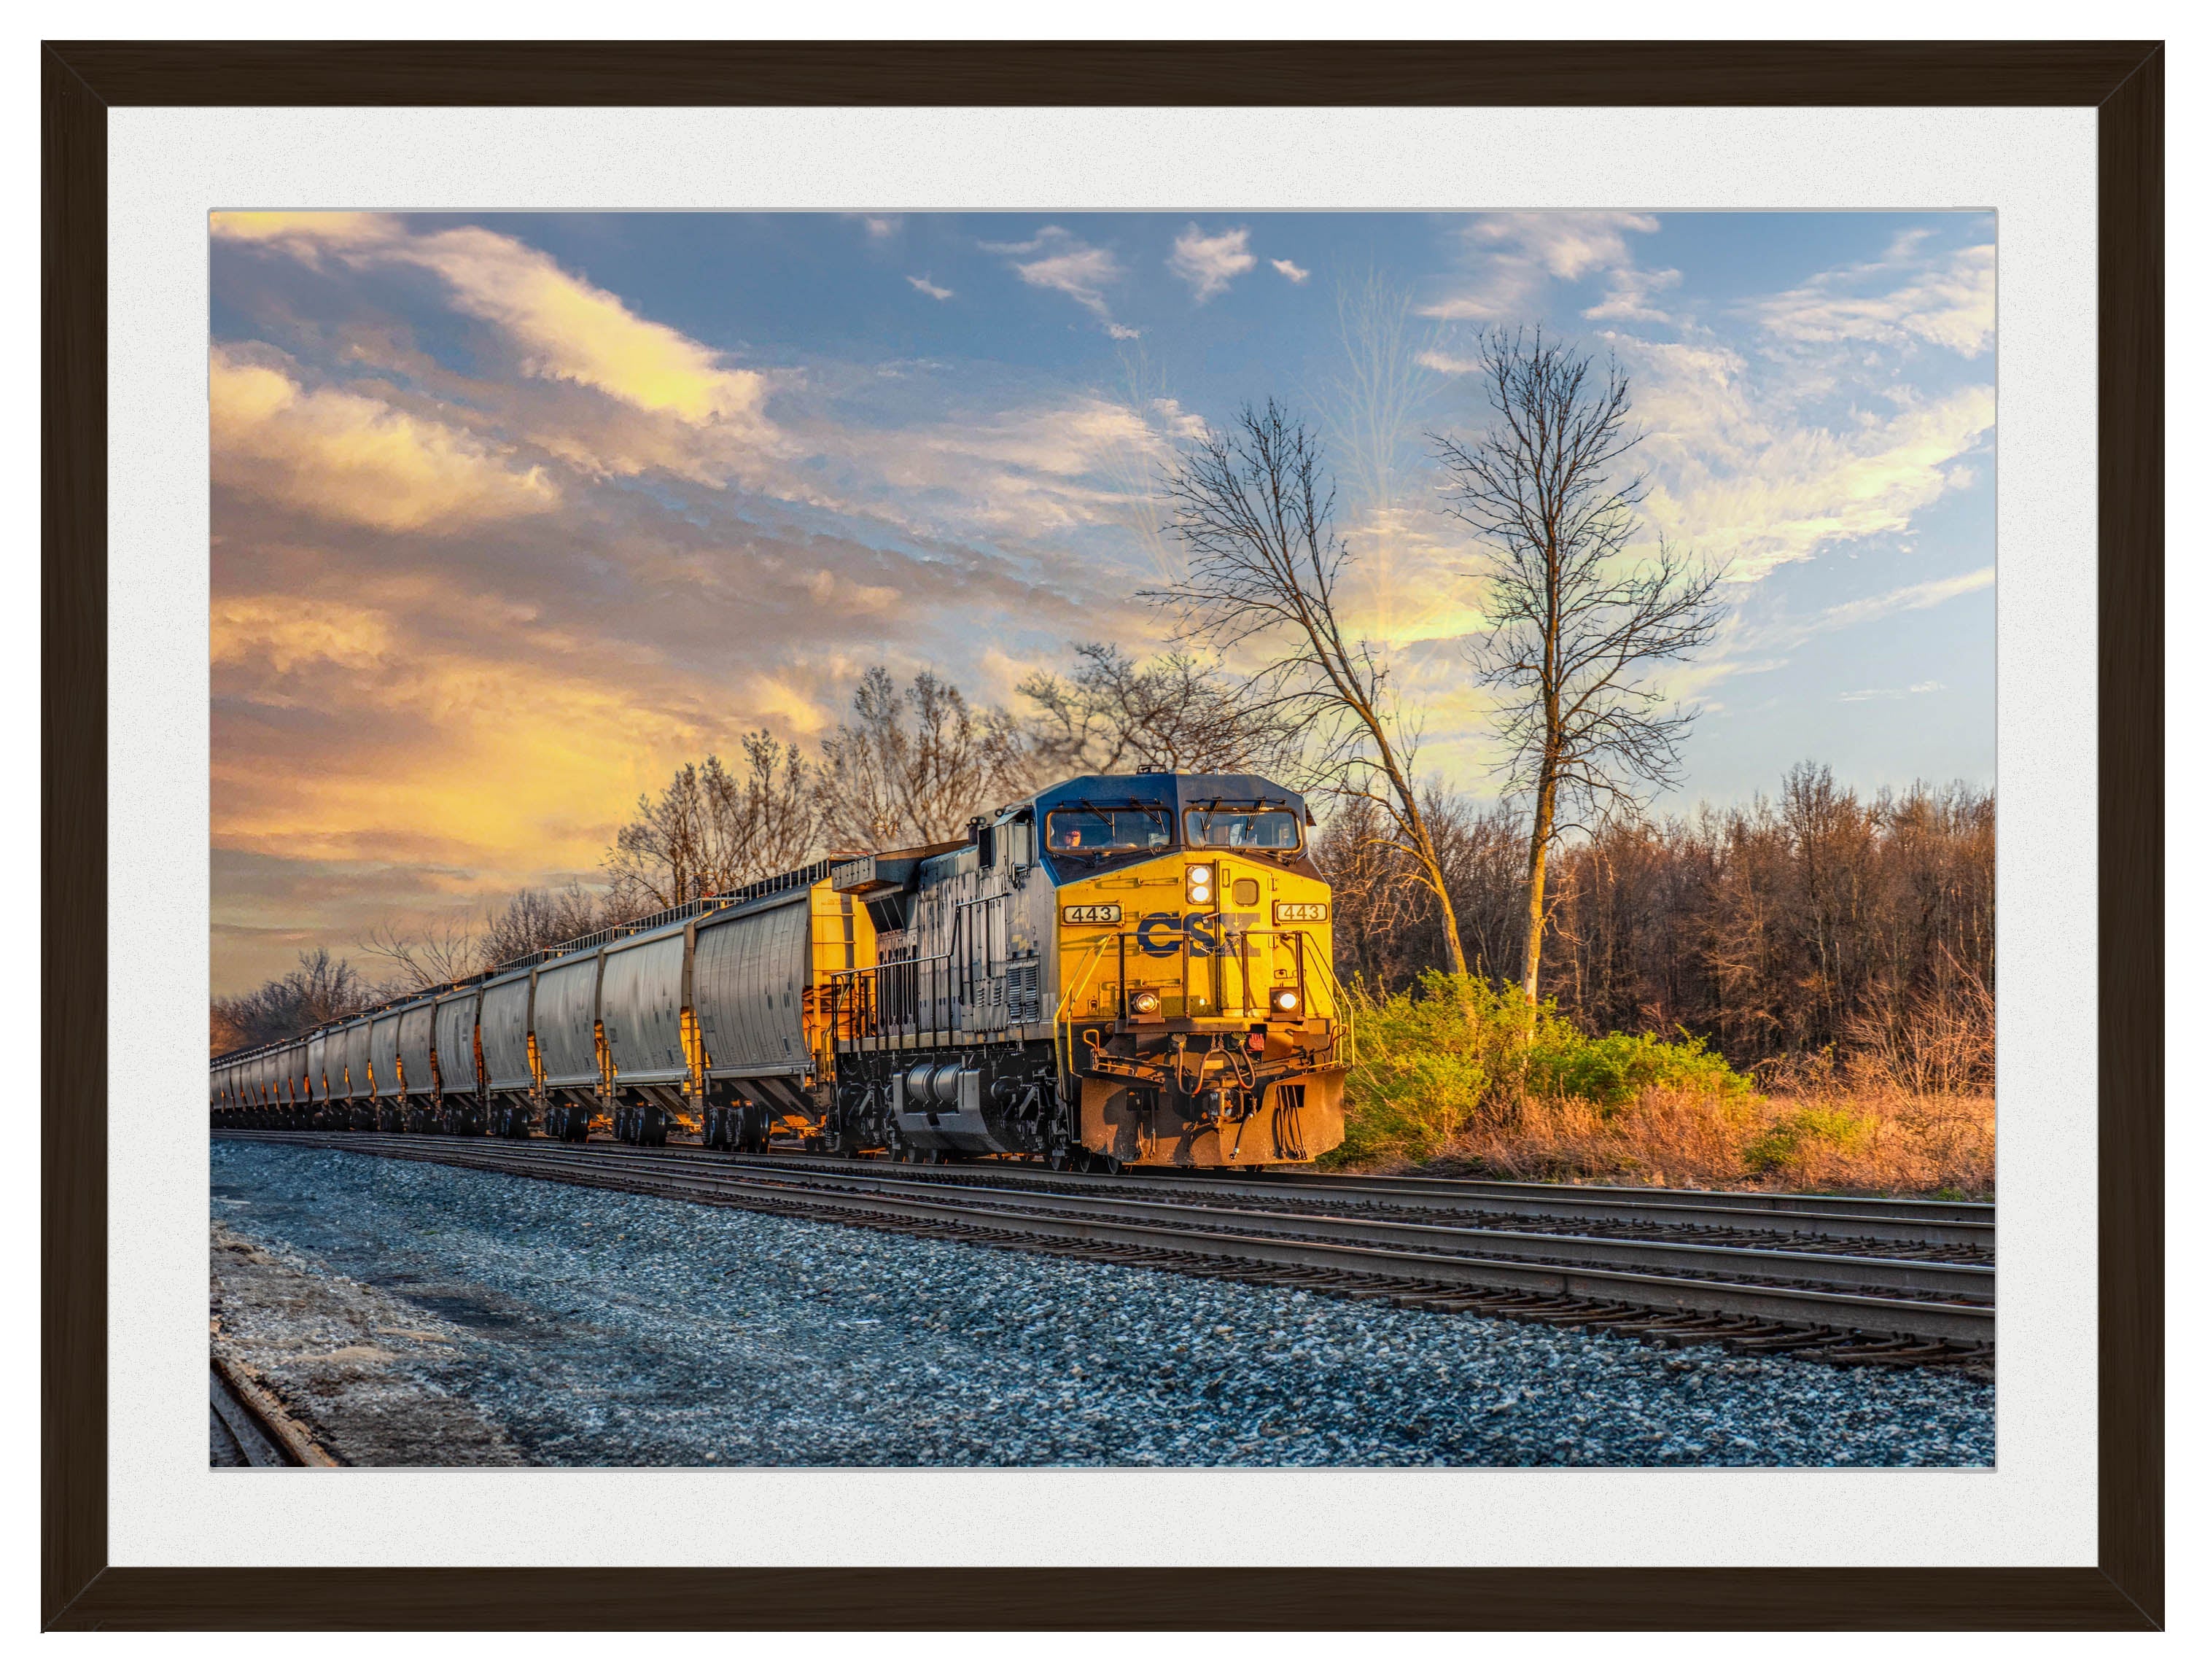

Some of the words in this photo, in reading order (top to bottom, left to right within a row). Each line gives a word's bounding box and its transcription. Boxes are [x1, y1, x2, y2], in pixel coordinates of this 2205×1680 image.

[1072, 906, 1112, 922] 443
[1283, 904, 1319, 919] 443
[1137, 912, 1261, 958] CSX
